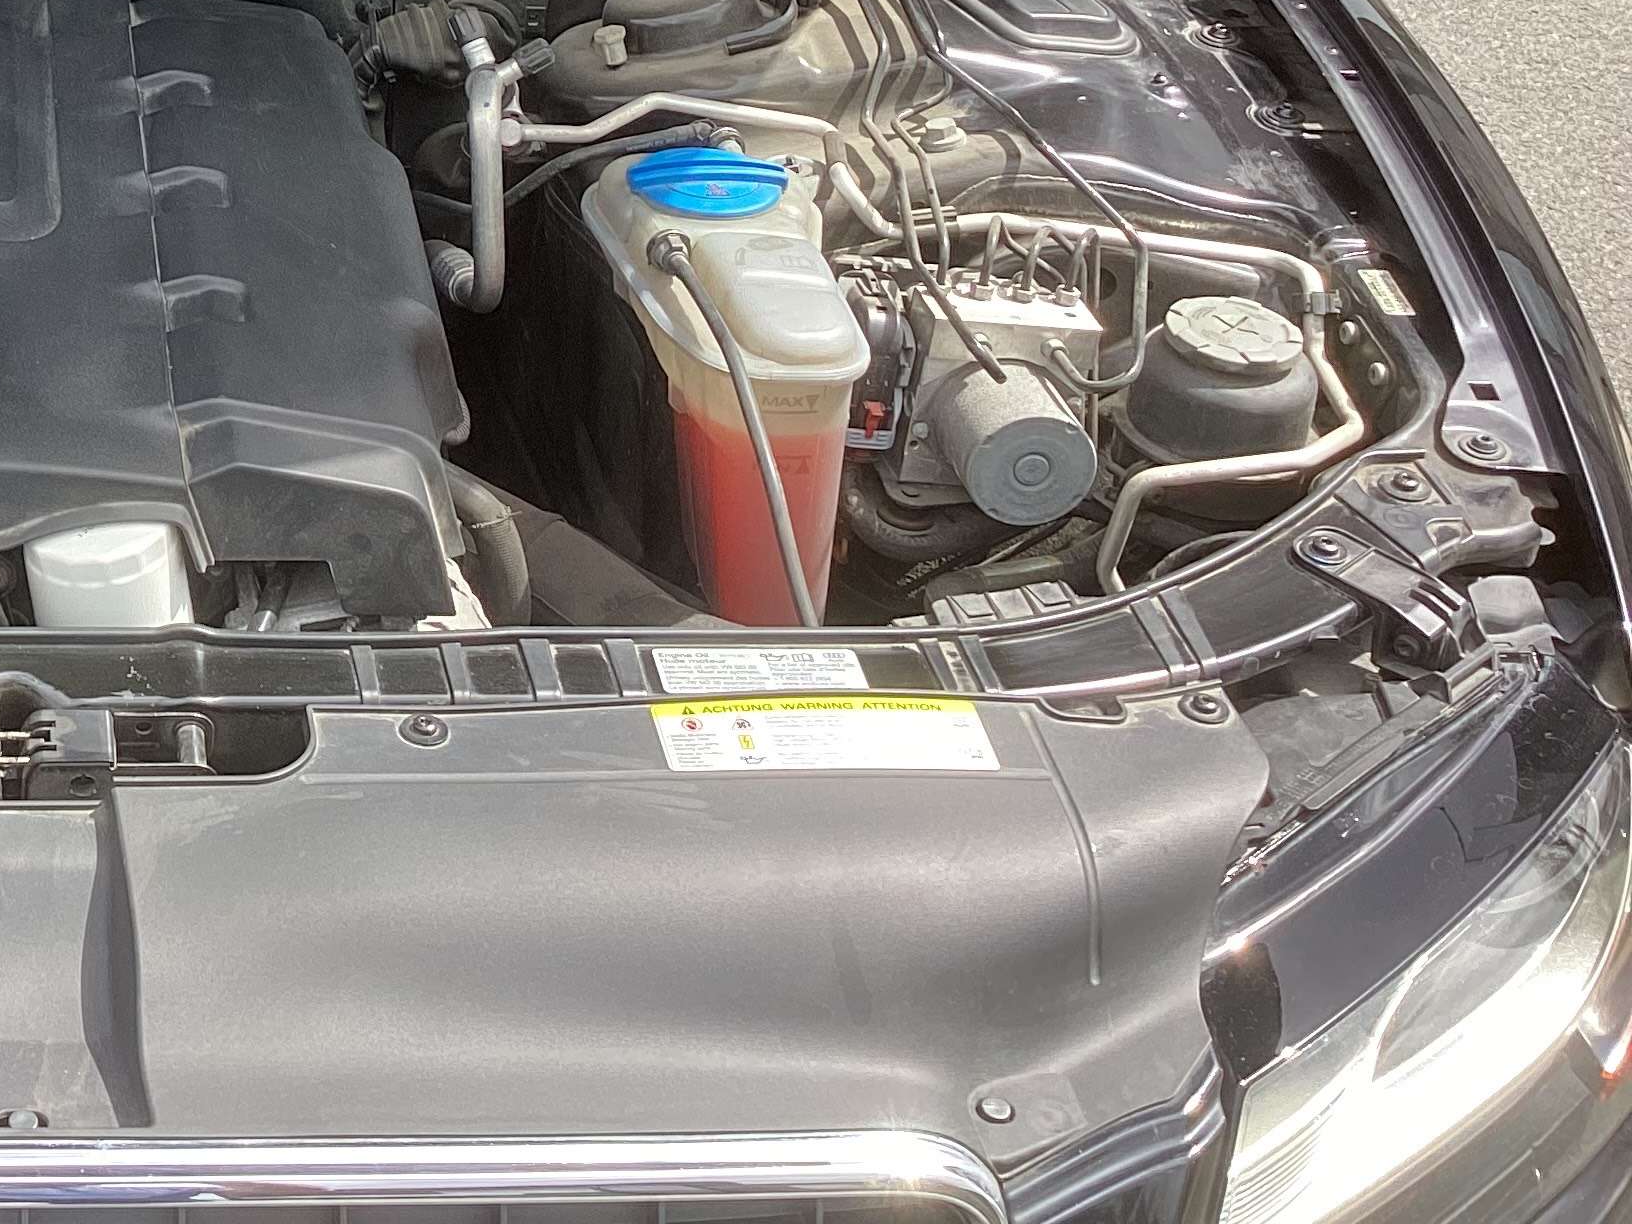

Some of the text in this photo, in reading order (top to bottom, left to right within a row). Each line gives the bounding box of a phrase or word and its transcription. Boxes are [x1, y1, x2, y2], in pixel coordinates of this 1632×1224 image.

[762, 396, 803, 408] MAX
[702, 702, 942, 714] ACHTUNG WARNING ATTENTION
